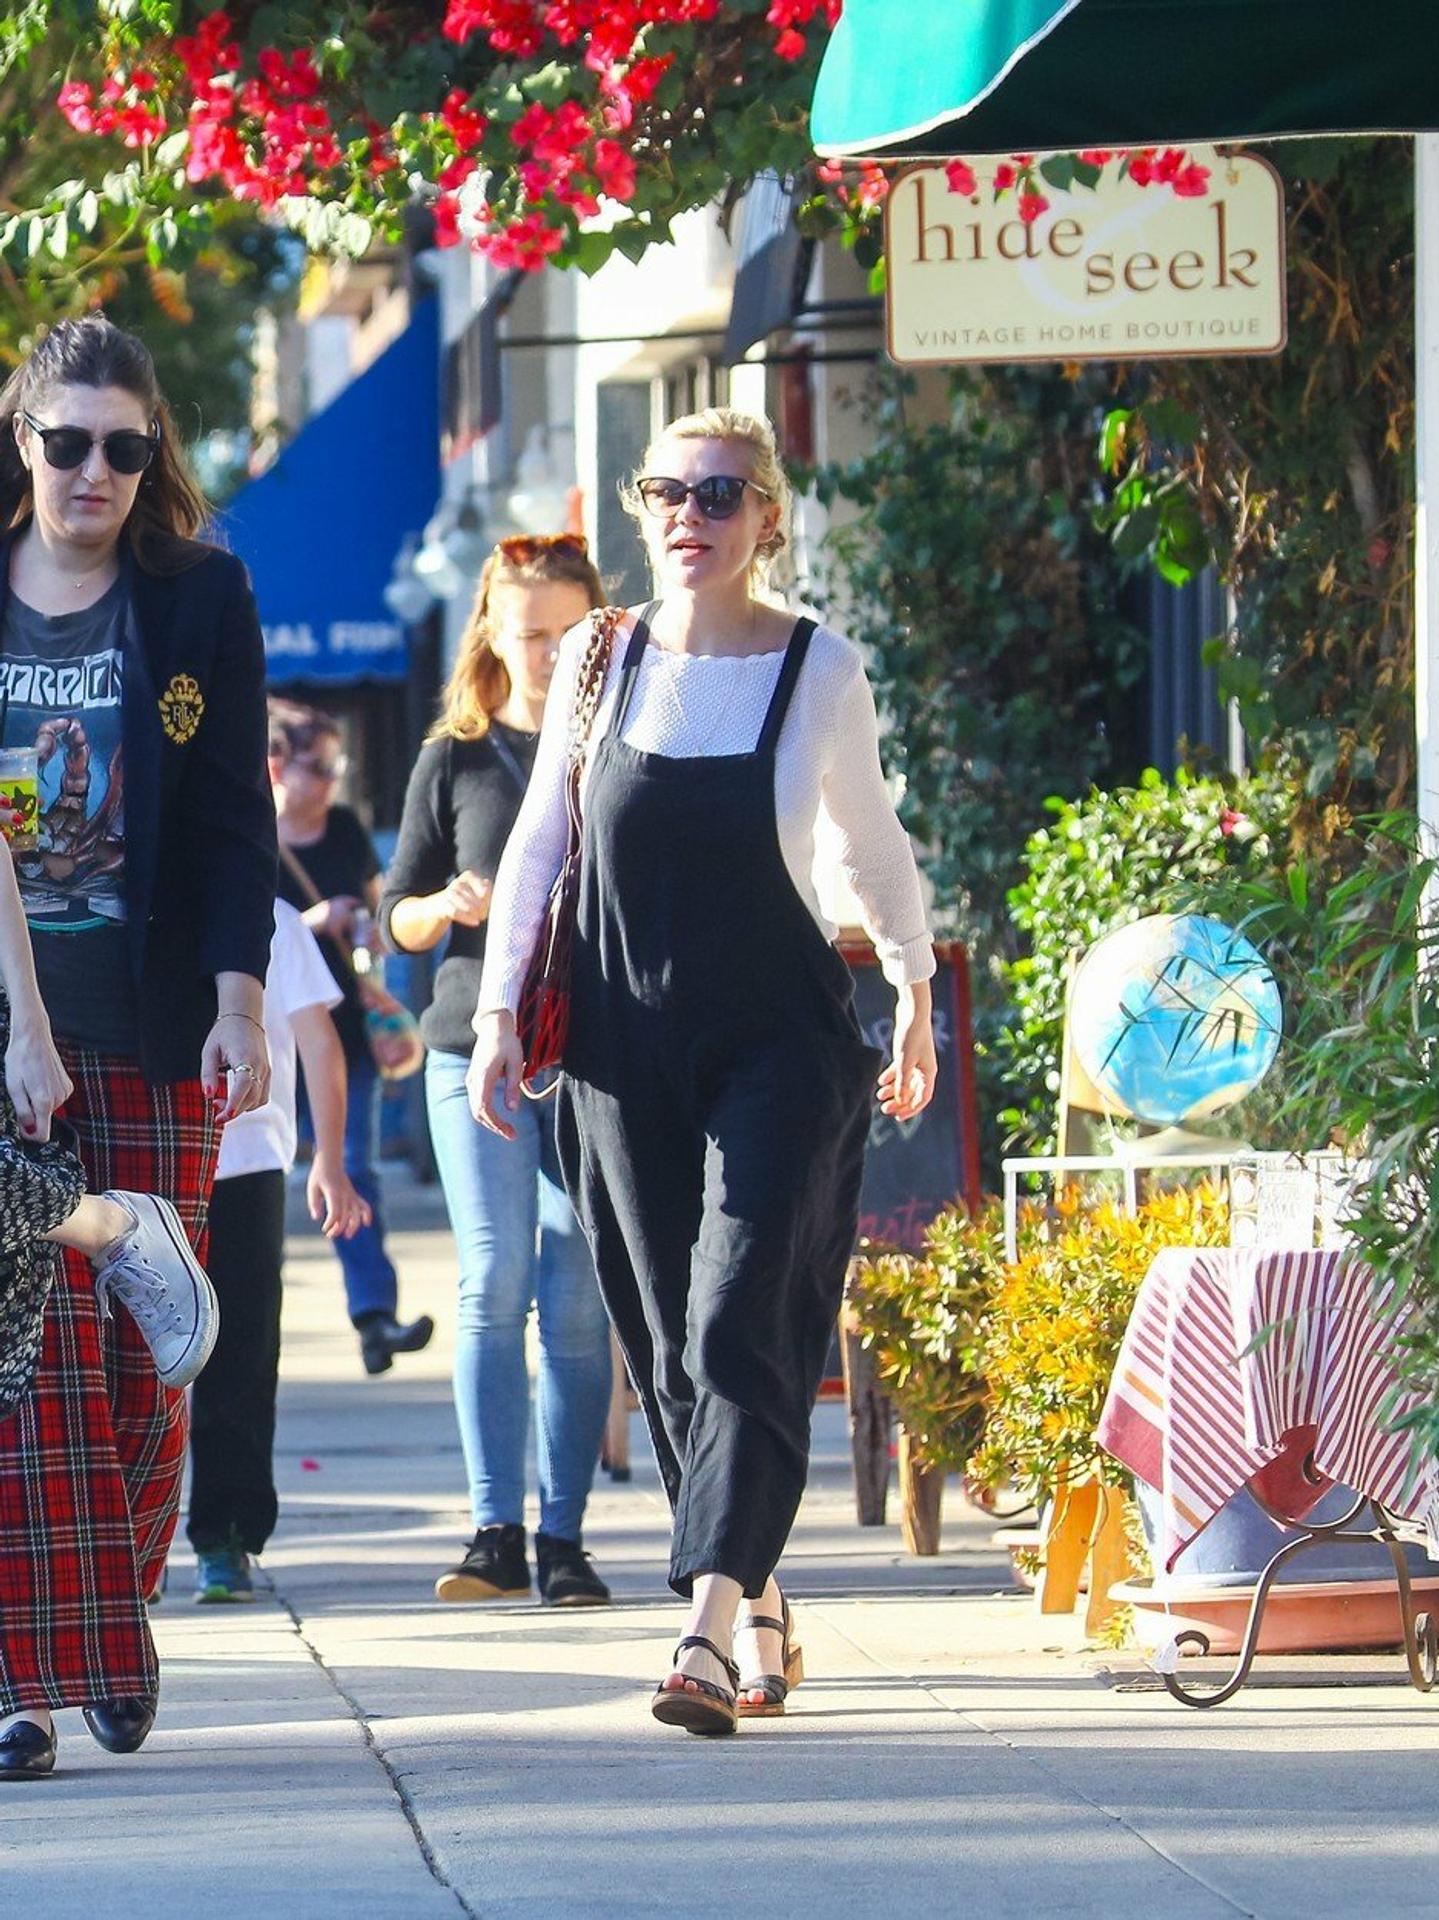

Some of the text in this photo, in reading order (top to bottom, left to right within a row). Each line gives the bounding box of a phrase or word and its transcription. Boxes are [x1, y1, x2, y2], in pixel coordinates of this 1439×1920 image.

[911, 176, 1084, 262] hide
[1084, 199, 1261, 296] seek
[914, 317, 1261, 346] VINTAGE HOME BOUTIQUE
